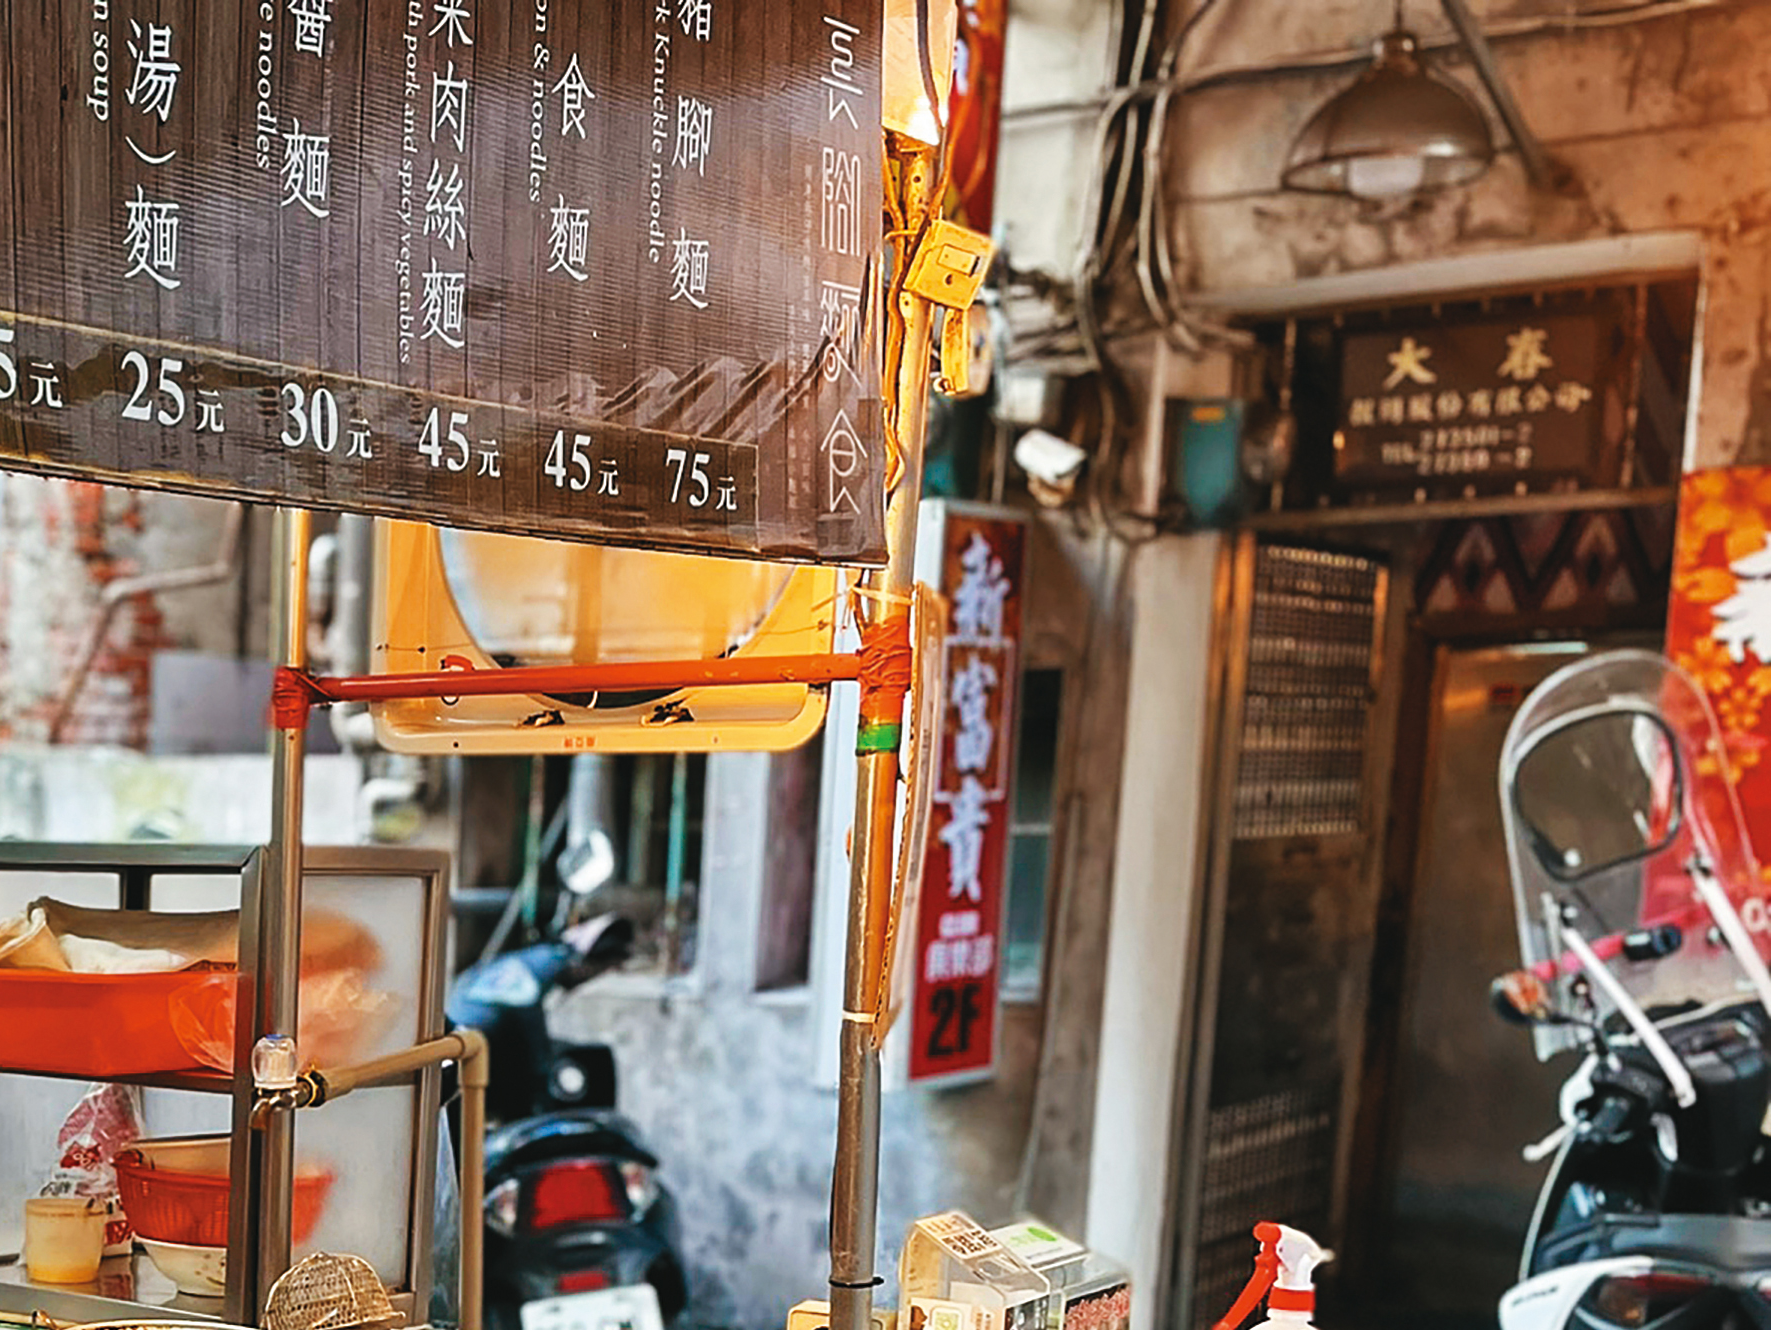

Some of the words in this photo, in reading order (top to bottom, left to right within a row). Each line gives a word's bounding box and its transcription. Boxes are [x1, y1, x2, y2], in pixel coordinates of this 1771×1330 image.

[86, 31, 108, 121] soup
[256, 31, 278, 169] noodles
[403, 33, 421, 100] pork
[533, 43, 550, 69] &
[651, 33, 670, 154] Knuckle
[402, 103, 418, 153] and
[529, 80, 547, 202] noodles
[396, 158, 413, 226] spicy
[648, 163, 665, 264] noodle
[394, 233, 415, 364] vegetables
[928, 983, 980, 1057] 2F
